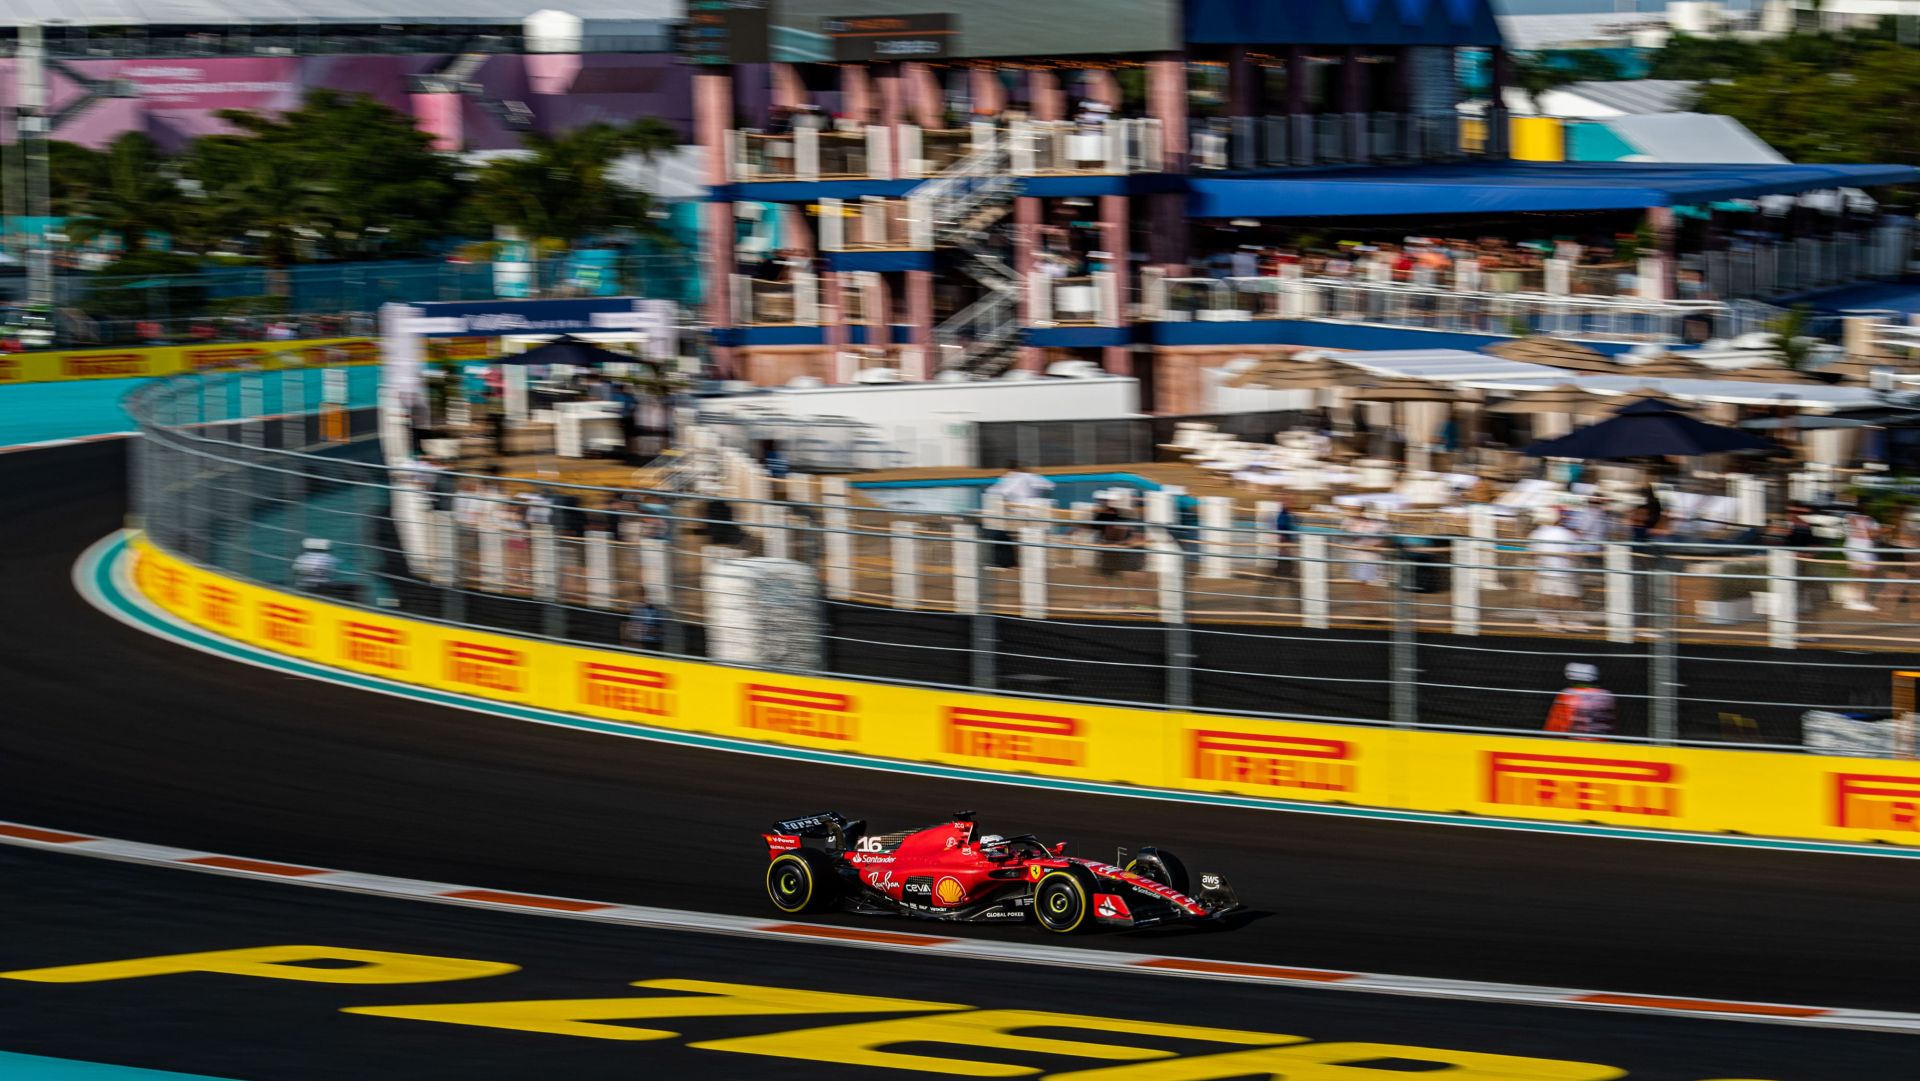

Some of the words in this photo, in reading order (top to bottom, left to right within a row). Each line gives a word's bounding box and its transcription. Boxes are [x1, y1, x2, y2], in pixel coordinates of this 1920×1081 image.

[443, 640, 528, 693] PIRELLI
[579, 662, 676, 717] PIRELLI
[739, 683, 867, 742] PIRELLI
[942, 706, 1085, 767] PIRELLI
[1186, 729, 1358, 792] PIRELLI
[1480, 751, 1684, 817] PIRELLI
[857, 836, 883, 853] 16
[861, 854, 896, 864] Santander
[1202, 875, 1220, 885] aws
[0, 945, 522, 985] P
[340, 978, 1780, 1081] ZER
